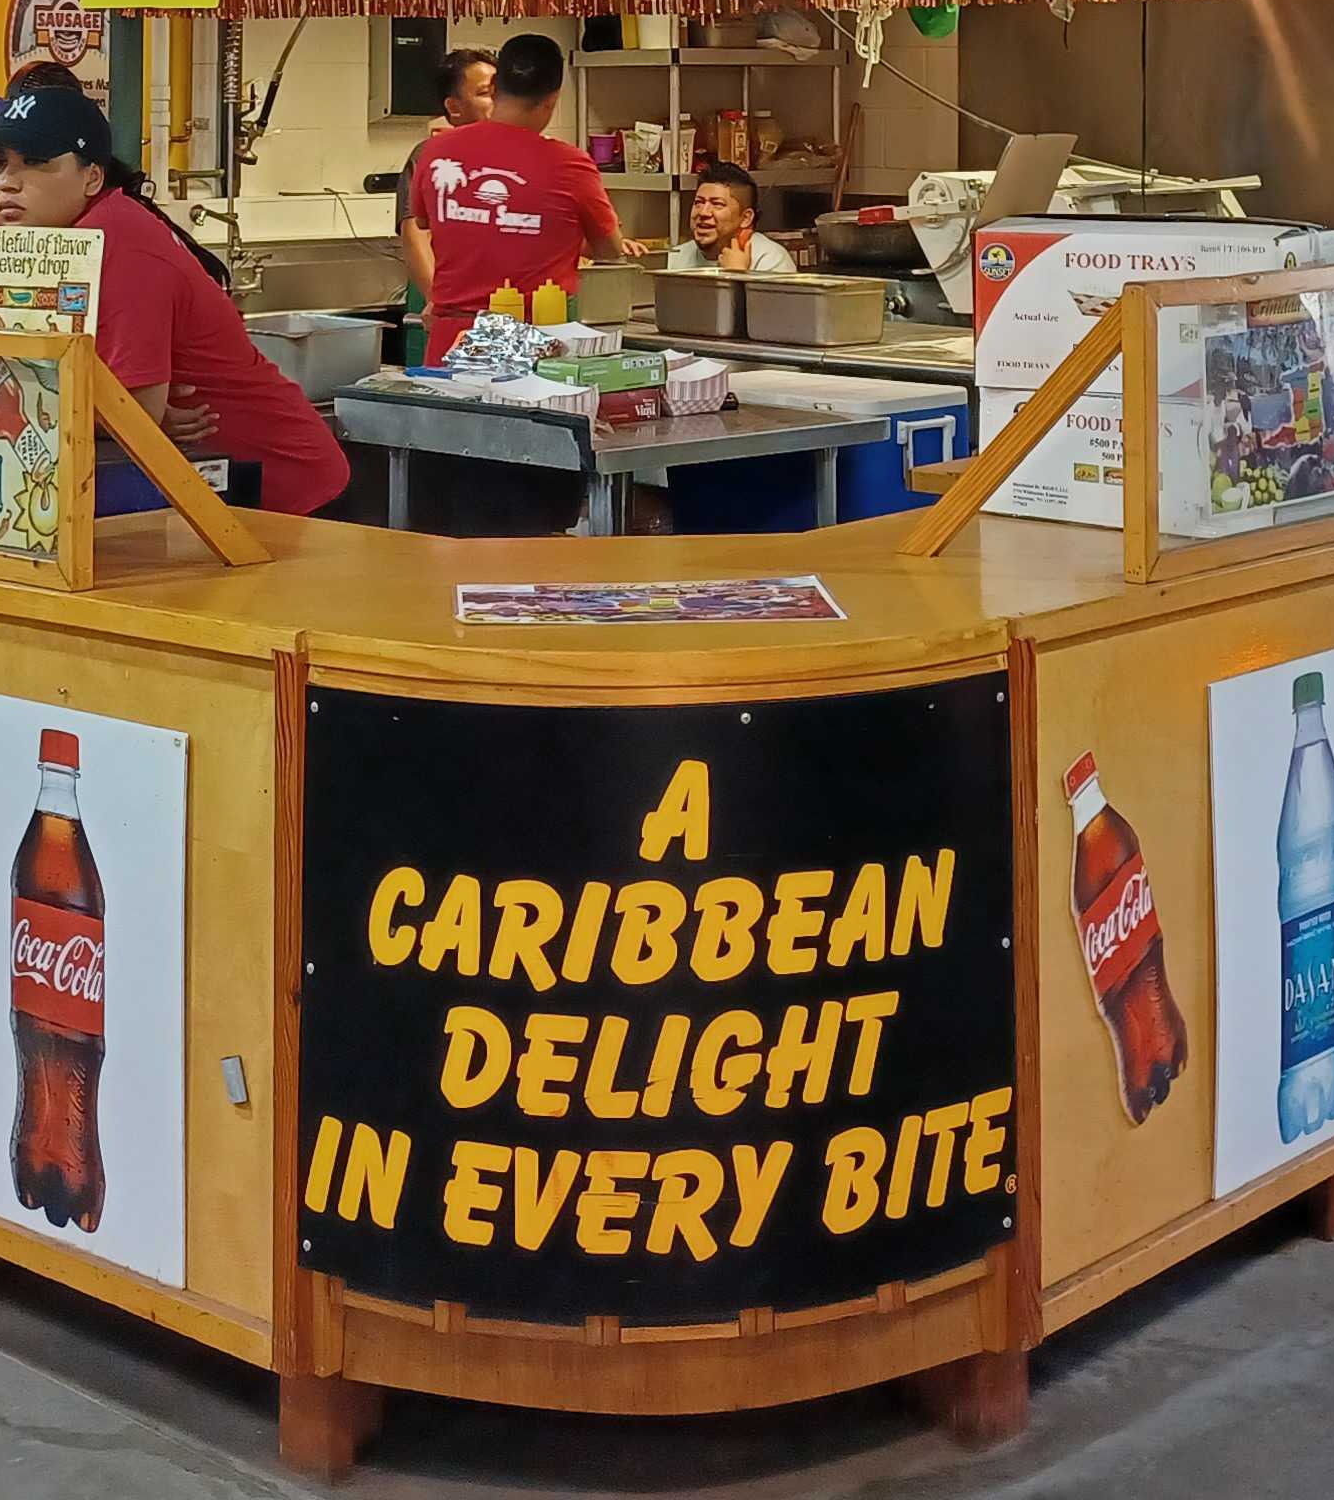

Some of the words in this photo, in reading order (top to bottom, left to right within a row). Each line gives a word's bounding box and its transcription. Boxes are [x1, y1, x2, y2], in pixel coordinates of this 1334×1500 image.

[37, 12, 101, 29] SAUSAGE
[0, 254, 36, 278] every
[37, 255, 71, 280] drop
[35, 231, 53, 255] of
[52, 233, 92, 257] flavor
[1064, 252, 1122, 270] FOOD
[1127, 253, 1197, 272] TRAYS
[1013, 311, 1043, 323] Actual
[1043, 313, 1059, 323] size
[1066, 412, 1112, 433] FOOD
[639, 760, 709, 862] A
[368, 848, 957, 992] CARIBBEAN
[1085, 864, 1153, 977] Coca-Cola
[11, 918, 104, 1004] Coca-Cola
[439, 991, 901, 1119] DELIGHT
[304, 1115, 412, 1230] IN
[443, 1140, 795, 1263] EVERY
[821, 1086, 1014, 1237] BITE
